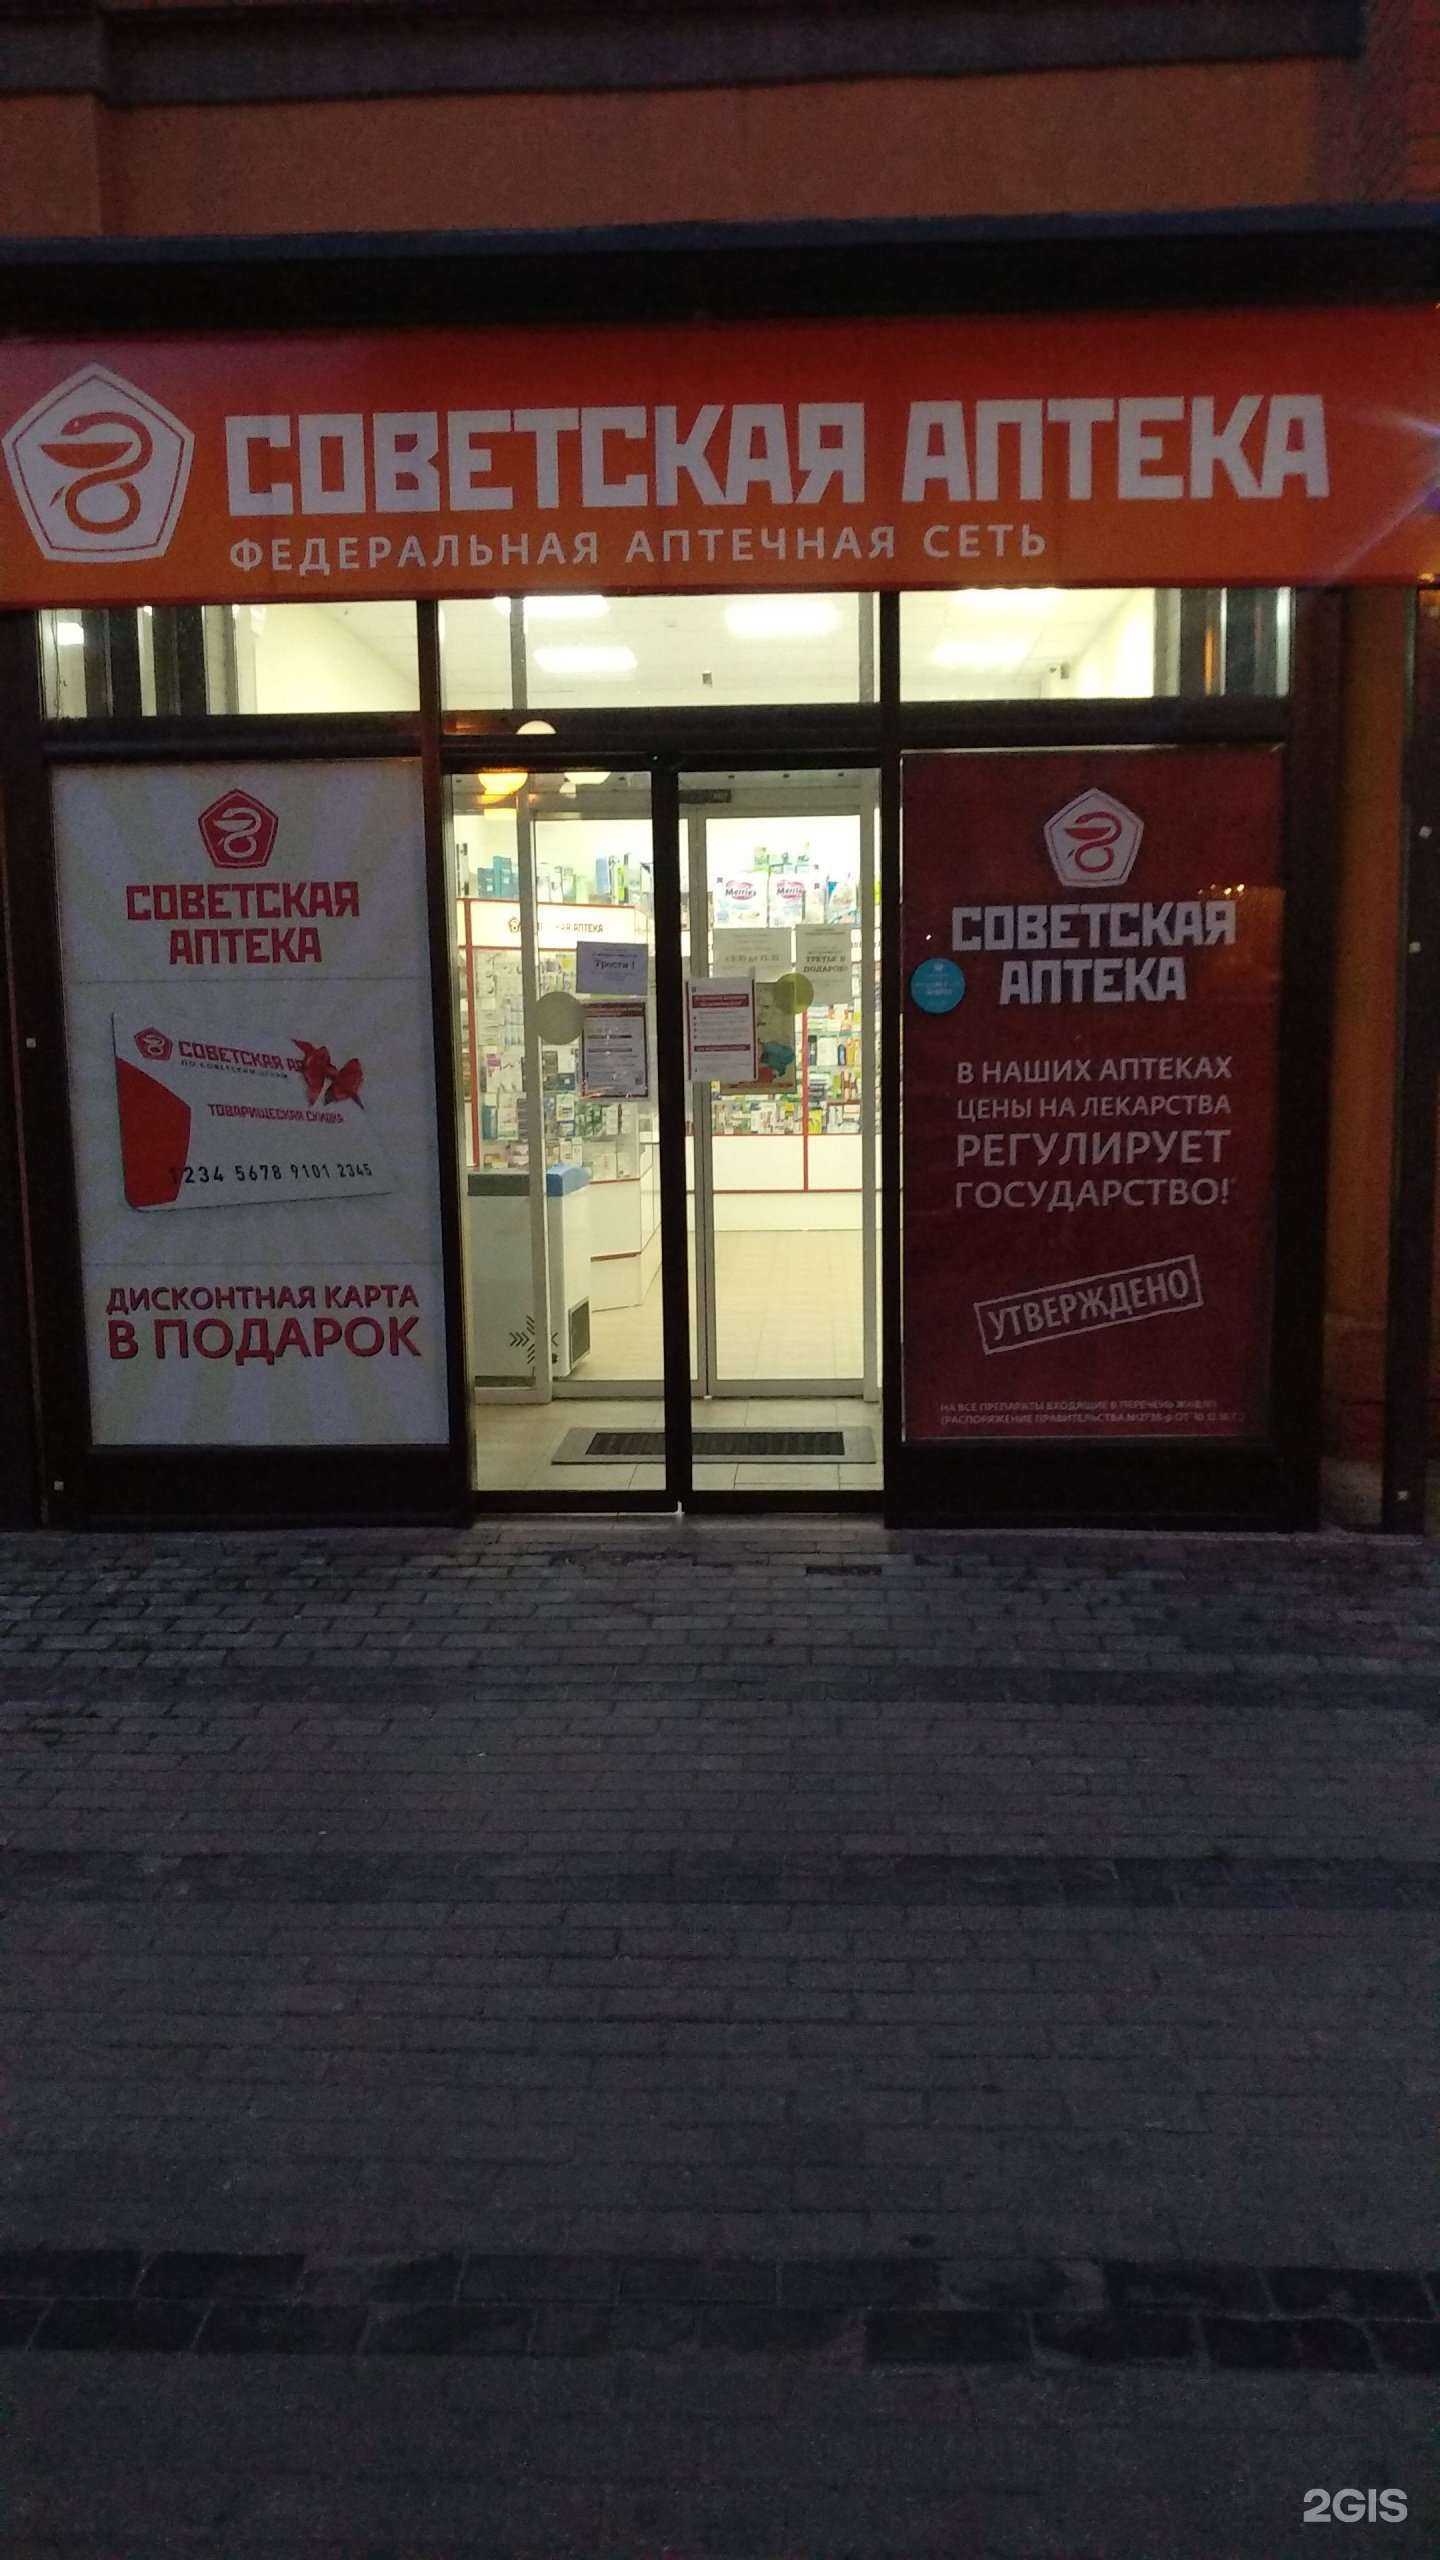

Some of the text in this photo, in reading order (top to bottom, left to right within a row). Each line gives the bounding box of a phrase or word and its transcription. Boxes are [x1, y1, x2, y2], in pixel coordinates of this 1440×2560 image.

[225, 394, 1330, 516] СОВЕТСКАЯ АПТЕКА
[230, 523, 1047, 576] ФЕДЕРАЛЬНАЯ АПТЕЧНАЯ СЕТЬ
[126, 881, 360, 920] СОВЕТСКАЯ
[951, 900, 1236, 951] СОВЕТСКАЯ
[169, 927, 322, 964] АПТЕКА
[1000, 957, 1187, 1005] АПТЕКА
[178, 1040, 285, 1071] СОВЕТСКАЯ
[956, 1056, 1232, 1084] В НАШИХ АПТЕКАХ
[957, 1094, 1232, 1122] ЦЕНЫ НА ЛЕКАРСТВА
[956, 1130, 1232, 1167] РЕГУЛИРУЕТ
[170, 1163, 373, 1185] 1234 5678 9101 2345
[956, 1178, 1230, 1213] ГОСУДАРСТВО!
[106, 1284, 420, 1315] ДИСКОНТНАЯ КАРТА
[987, 1268, 1190, 1341] УТВЕРЖДЕНО
[107, 1315, 421, 1366] В ПОДАРОК
